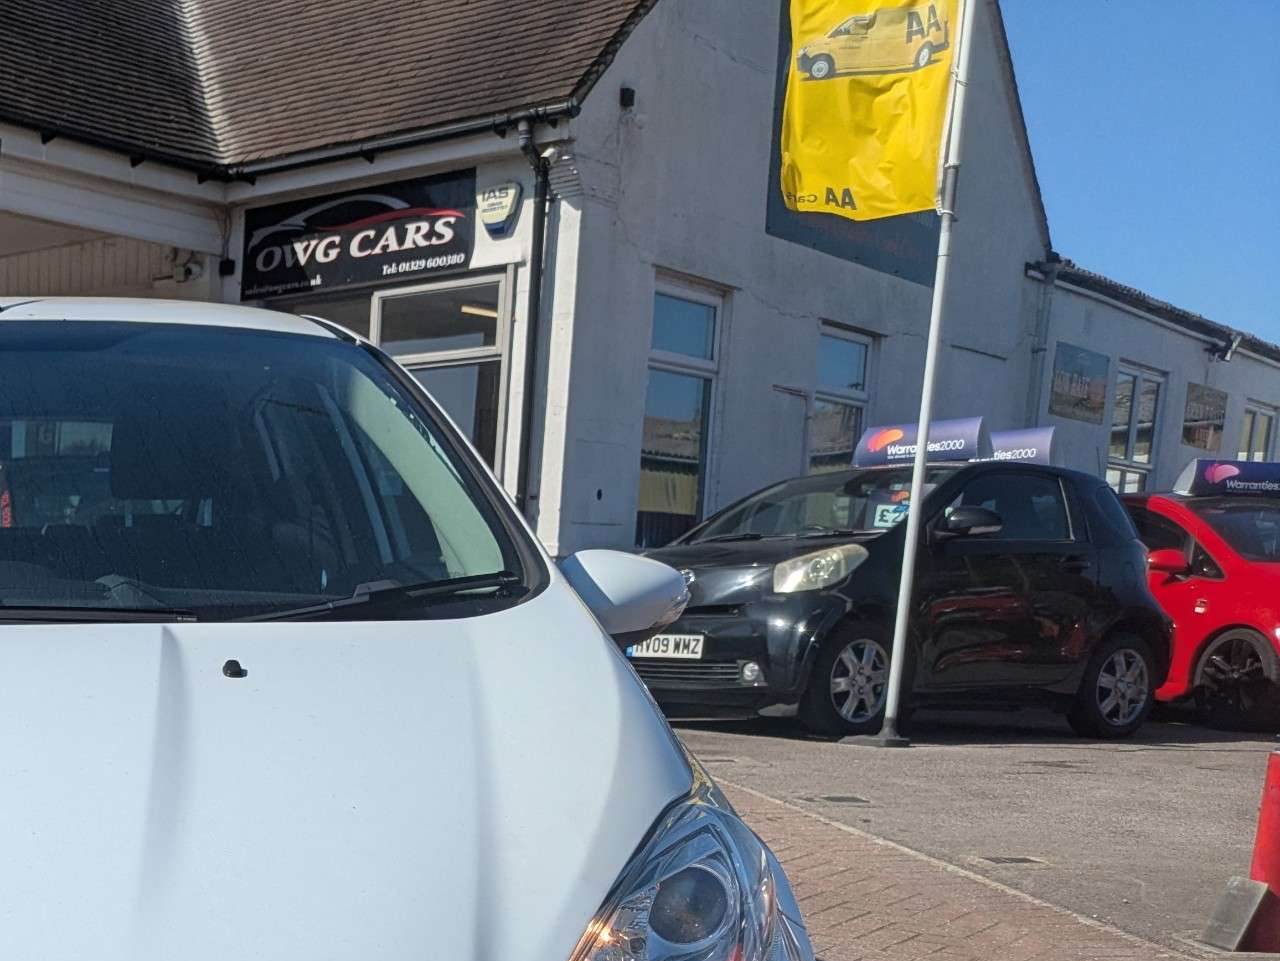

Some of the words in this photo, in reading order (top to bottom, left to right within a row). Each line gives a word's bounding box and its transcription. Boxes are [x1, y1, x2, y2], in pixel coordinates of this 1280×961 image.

[256, 235, 341, 272] OWG
[349, 216, 457, 258] CARS
[399, 258, 426, 273] 01329
[427, 253, 465, 269] 600380
[887, 439, 965, 454] Warraies2000
[672, 638, 702, 655] WMZ
